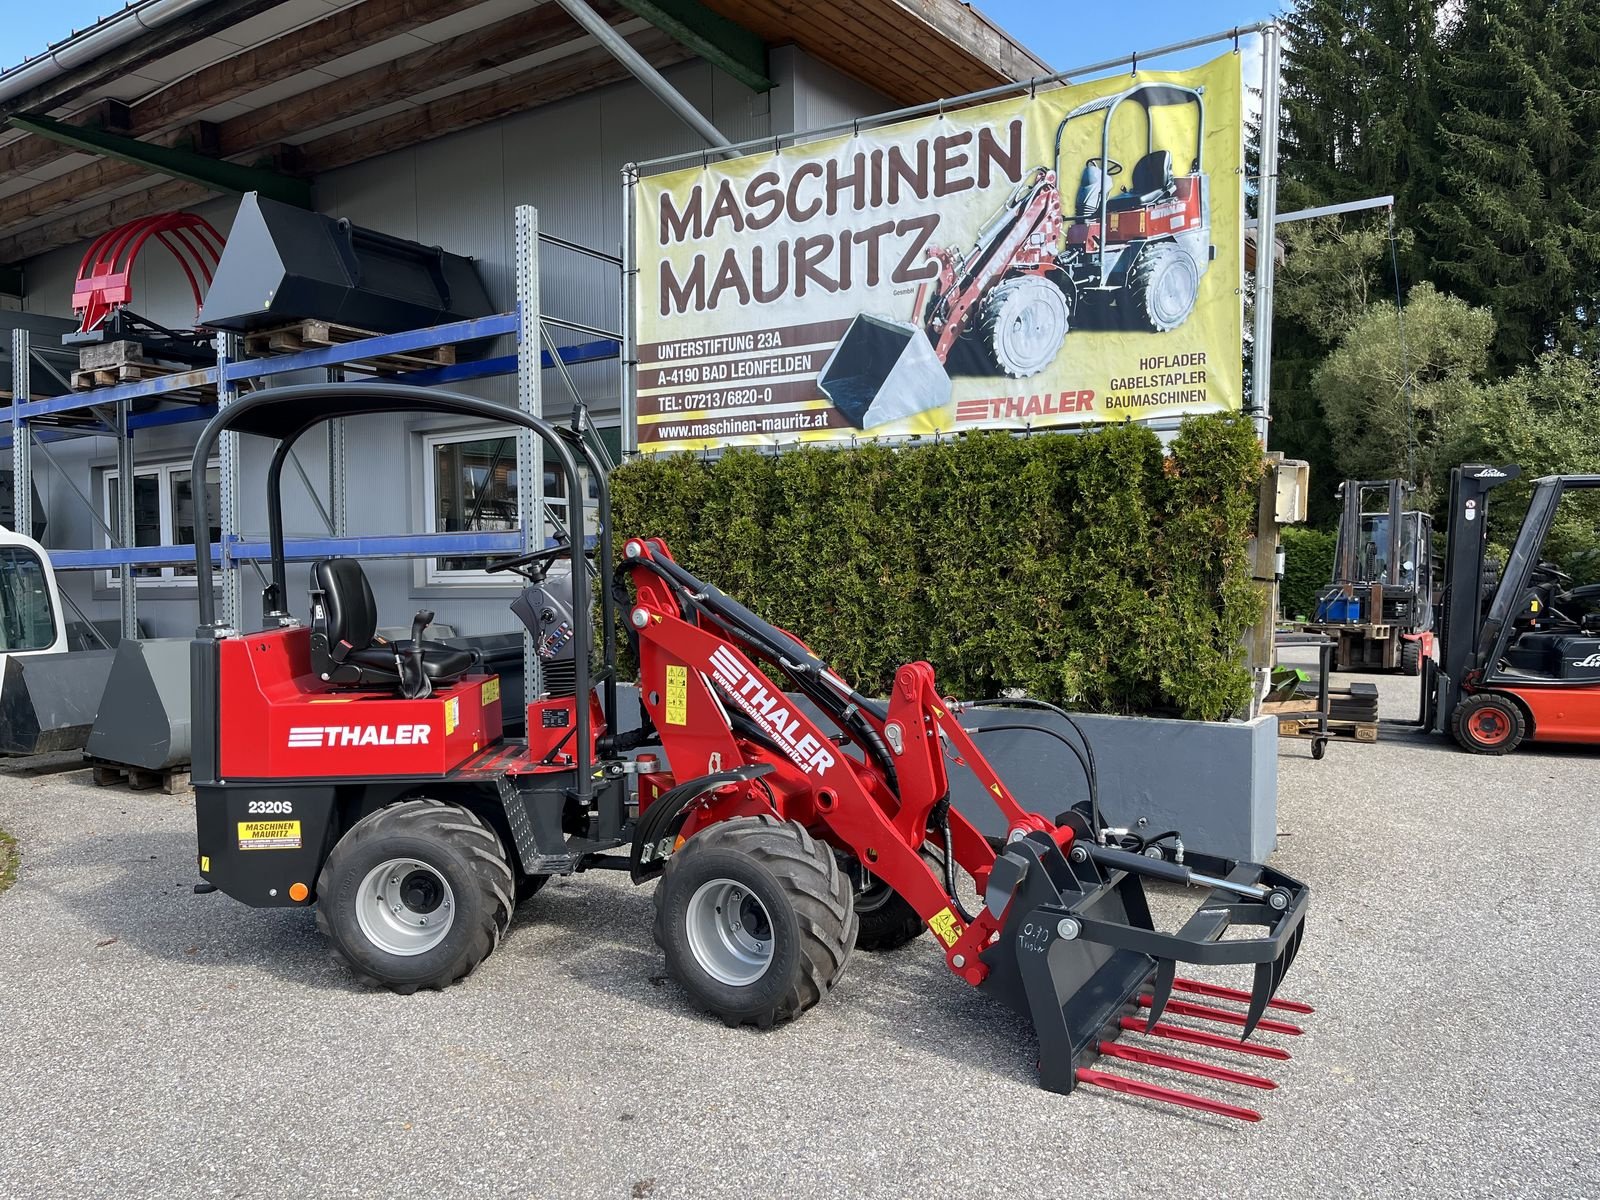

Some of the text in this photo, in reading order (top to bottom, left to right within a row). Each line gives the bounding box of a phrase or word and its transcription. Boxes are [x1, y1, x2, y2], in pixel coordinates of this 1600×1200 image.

[660, 120, 1022, 246] MASCHINEN
[660, 213, 940, 316] MAURITZ
[658, 331, 782, 359] UNTERSTIFTUNG 23A
[658, 354, 812, 385] A-4190 BAD LEONFELDEN
[1140, 352, 1206, 370] HOFLADER
[1110, 370, 1206, 391] GABELSTAPLER
[658, 387, 772, 411] TEL: 07213/6820-0
[989, 389, 1095, 418] THALER
[1106, 389, 1206, 409] BAUMASCHINEN
[658, 411, 829, 438] www.maschinen-mauritz.at
[324, 724, 431, 746] THALER
[711, 670, 813, 775] www.maschinen-mauritz.at
[738, 671, 836, 777] THALER
[248, 800, 293, 814] 2320S
[245, 822, 294, 831] MASCHINEN
[251, 830, 288, 838] MAURITZ
